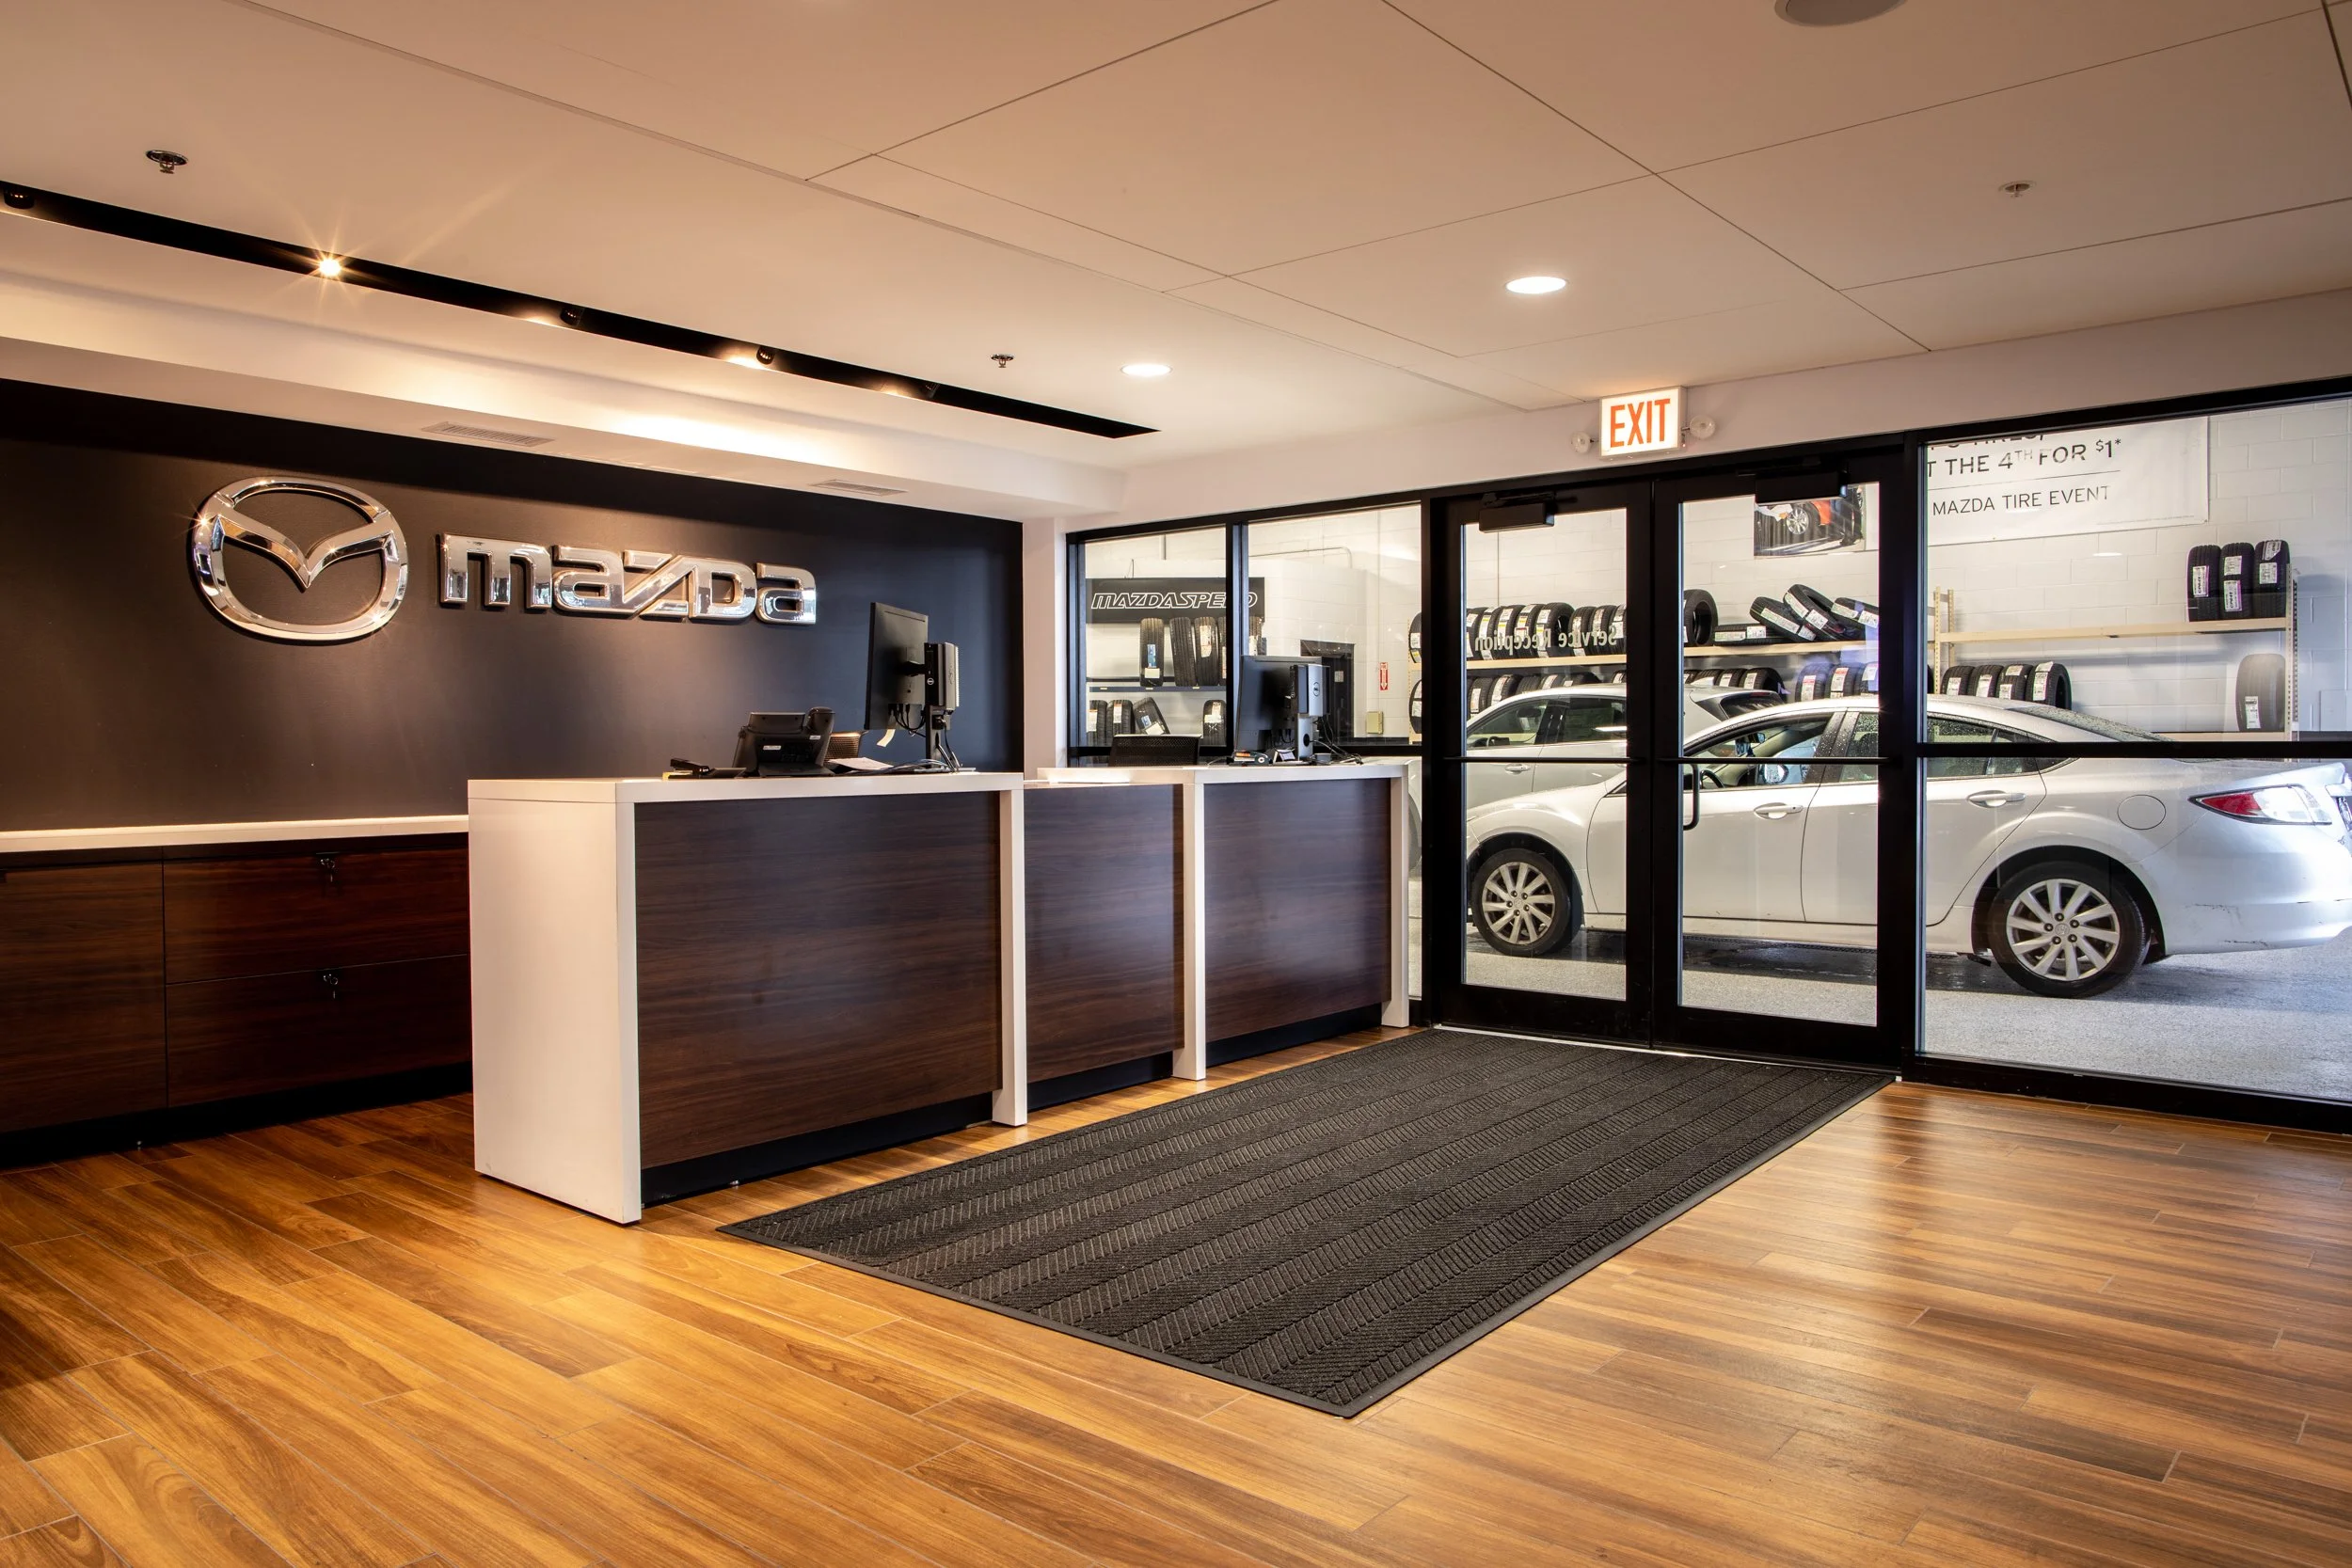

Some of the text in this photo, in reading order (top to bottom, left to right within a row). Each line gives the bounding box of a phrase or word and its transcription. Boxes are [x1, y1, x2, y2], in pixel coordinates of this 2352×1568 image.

[1610, 398, 1671, 448] EXIT
[1945, 455, 1990, 475] THE
[1998, 449, 2033, 469] 4TH
[2039, 444, 2087, 465] FOR
[1933, 485, 2110, 515] MAZDA TIRE EVENT
[1091, 592, 1258, 609] MAZDASPE
